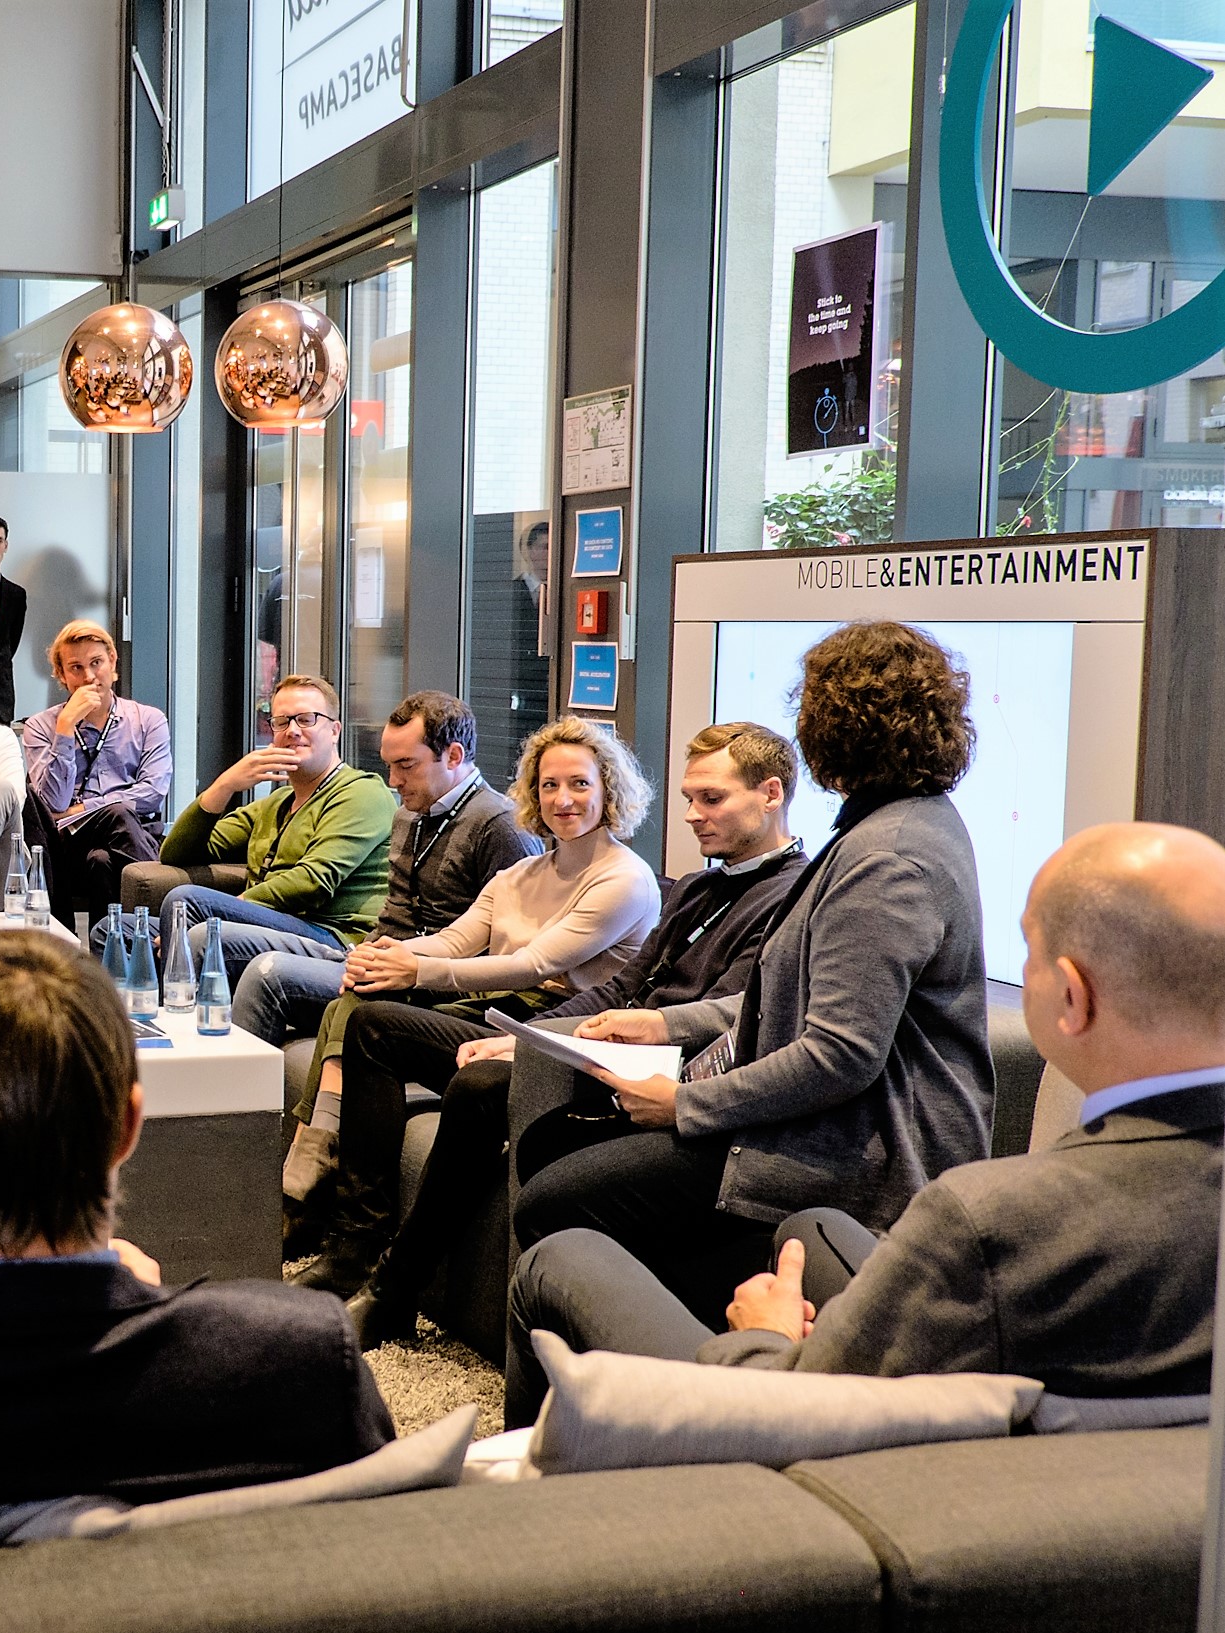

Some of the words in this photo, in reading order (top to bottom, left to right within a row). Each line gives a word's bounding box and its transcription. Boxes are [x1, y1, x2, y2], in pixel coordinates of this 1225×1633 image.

[817, 295, 834, 309] Stick
[835, 294, 843, 304] to
[808, 313, 820, 324] the
[820, 309, 836, 320] time
[836, 303, 851, 316] and
[809, 324, 827, 336] keep
[827, 319, 849, 333] going
[797, 545, 1145, 590] MOBILE&ENTERTAINMENT
